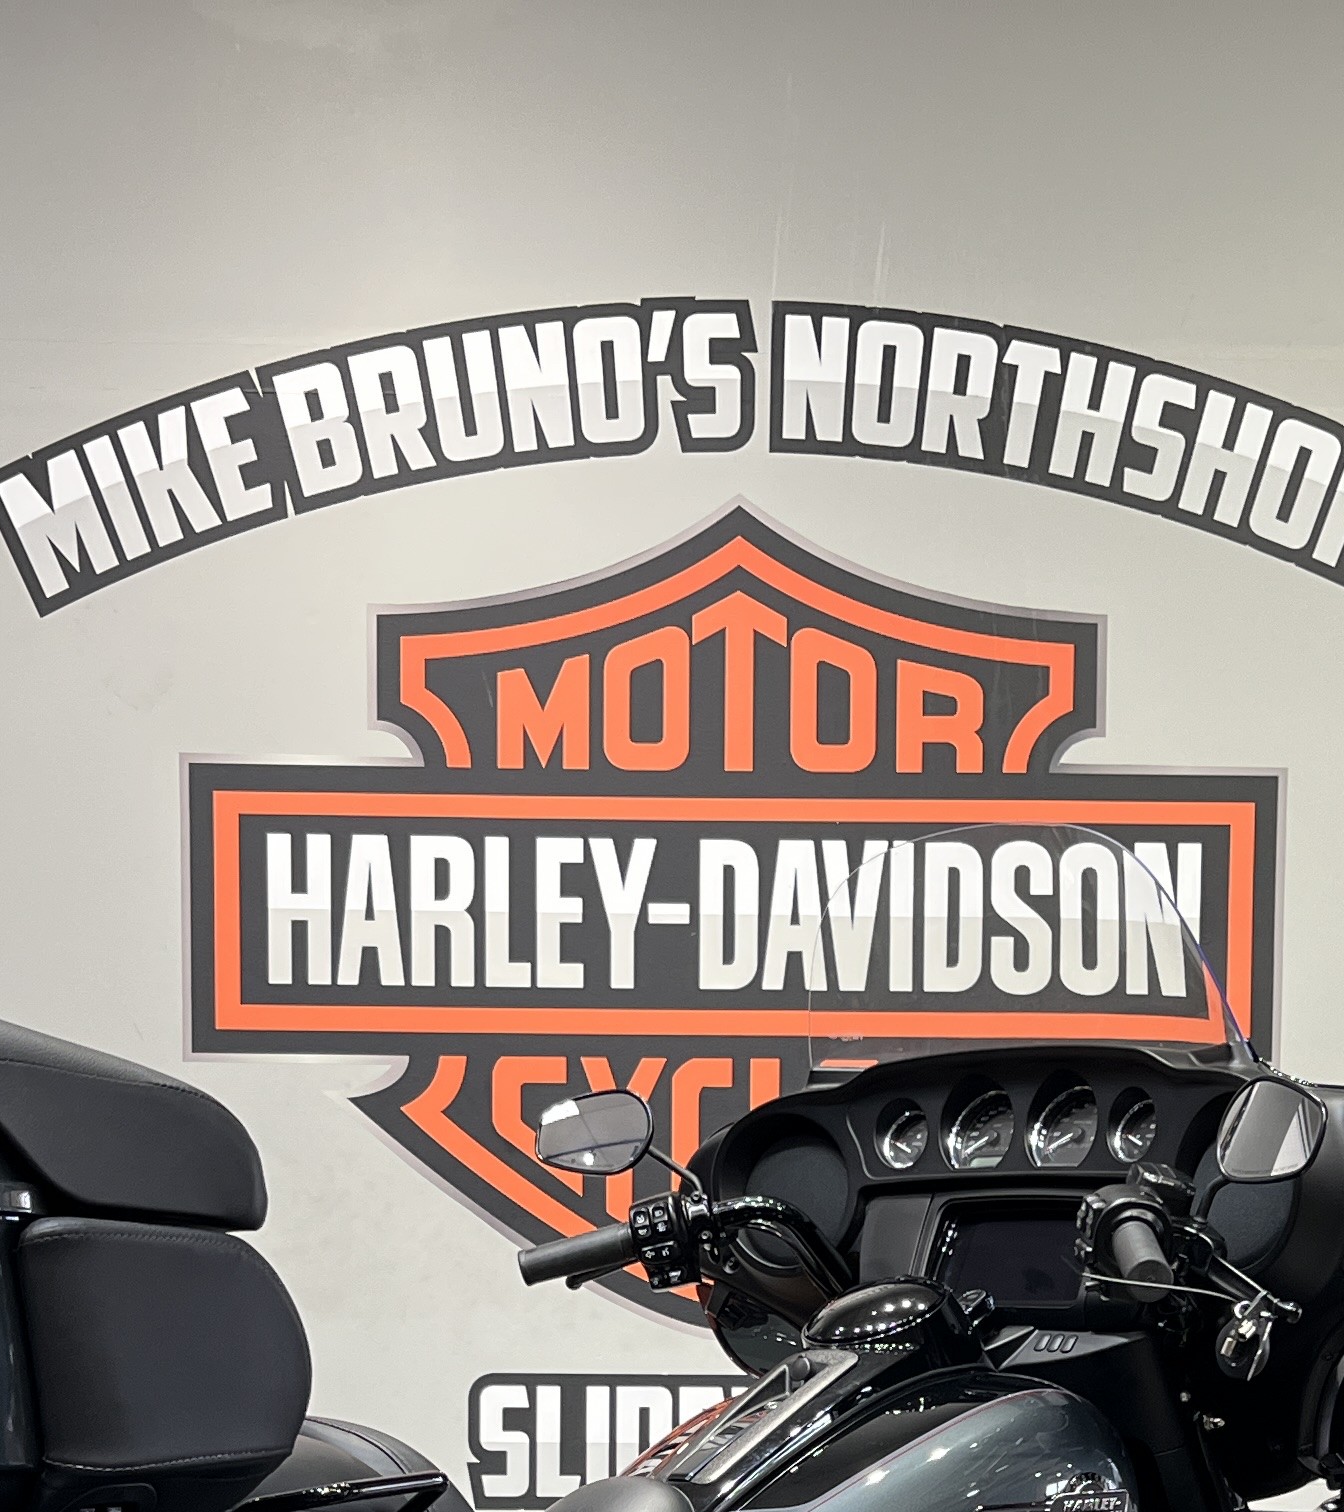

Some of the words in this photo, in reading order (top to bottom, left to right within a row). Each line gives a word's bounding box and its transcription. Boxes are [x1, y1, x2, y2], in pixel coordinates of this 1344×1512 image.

[272, 310, 742, 498] BRUNO'S
[496, 590, 984, 774] MOTOR
[265, 833, 1203, 997] HARLEY-DAVIDSON
